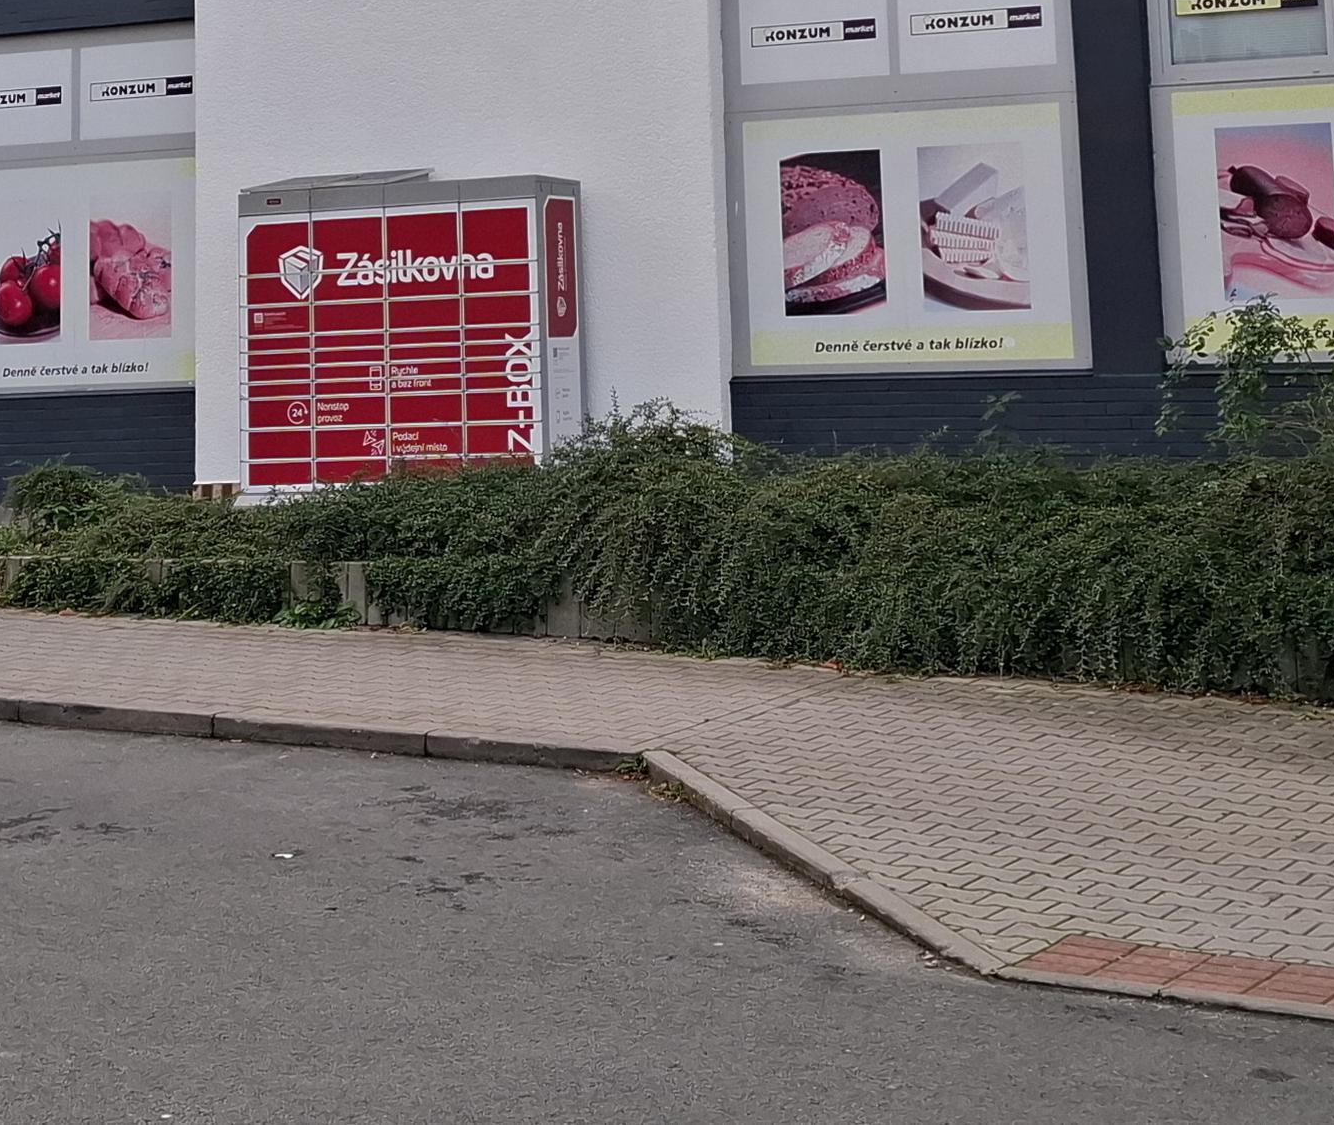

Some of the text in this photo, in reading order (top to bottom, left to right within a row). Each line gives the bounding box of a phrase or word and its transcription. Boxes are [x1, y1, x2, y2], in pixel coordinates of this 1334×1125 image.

[923, 10, 1041, 30] KONZUM market
[764, 23, 876, 42] KONZUM market
[101, 82, 156, 97] KONZUM
[557, 221, 565, 292] Zásilkovna
[335, 249, 495, 287] Zásilkovna
[814, 336, 1004, 353] Denně čerstvé a tak blízko!
[39, 364, 78, 376] čerstvé
[81, 366, 88, 375] a
[91, 363, 108, 374] tak
[111, 361, 149, 373] blízko!
[391, 366, 419, 377] Rychle
[505, 333, 534, 453] Z-BOX
[292, 408, 303, 418] 24
[317, 402, 349, 412] Nonstop
[317, 415, 343, 424] provoz
[426, 442, 448, 452] místo
